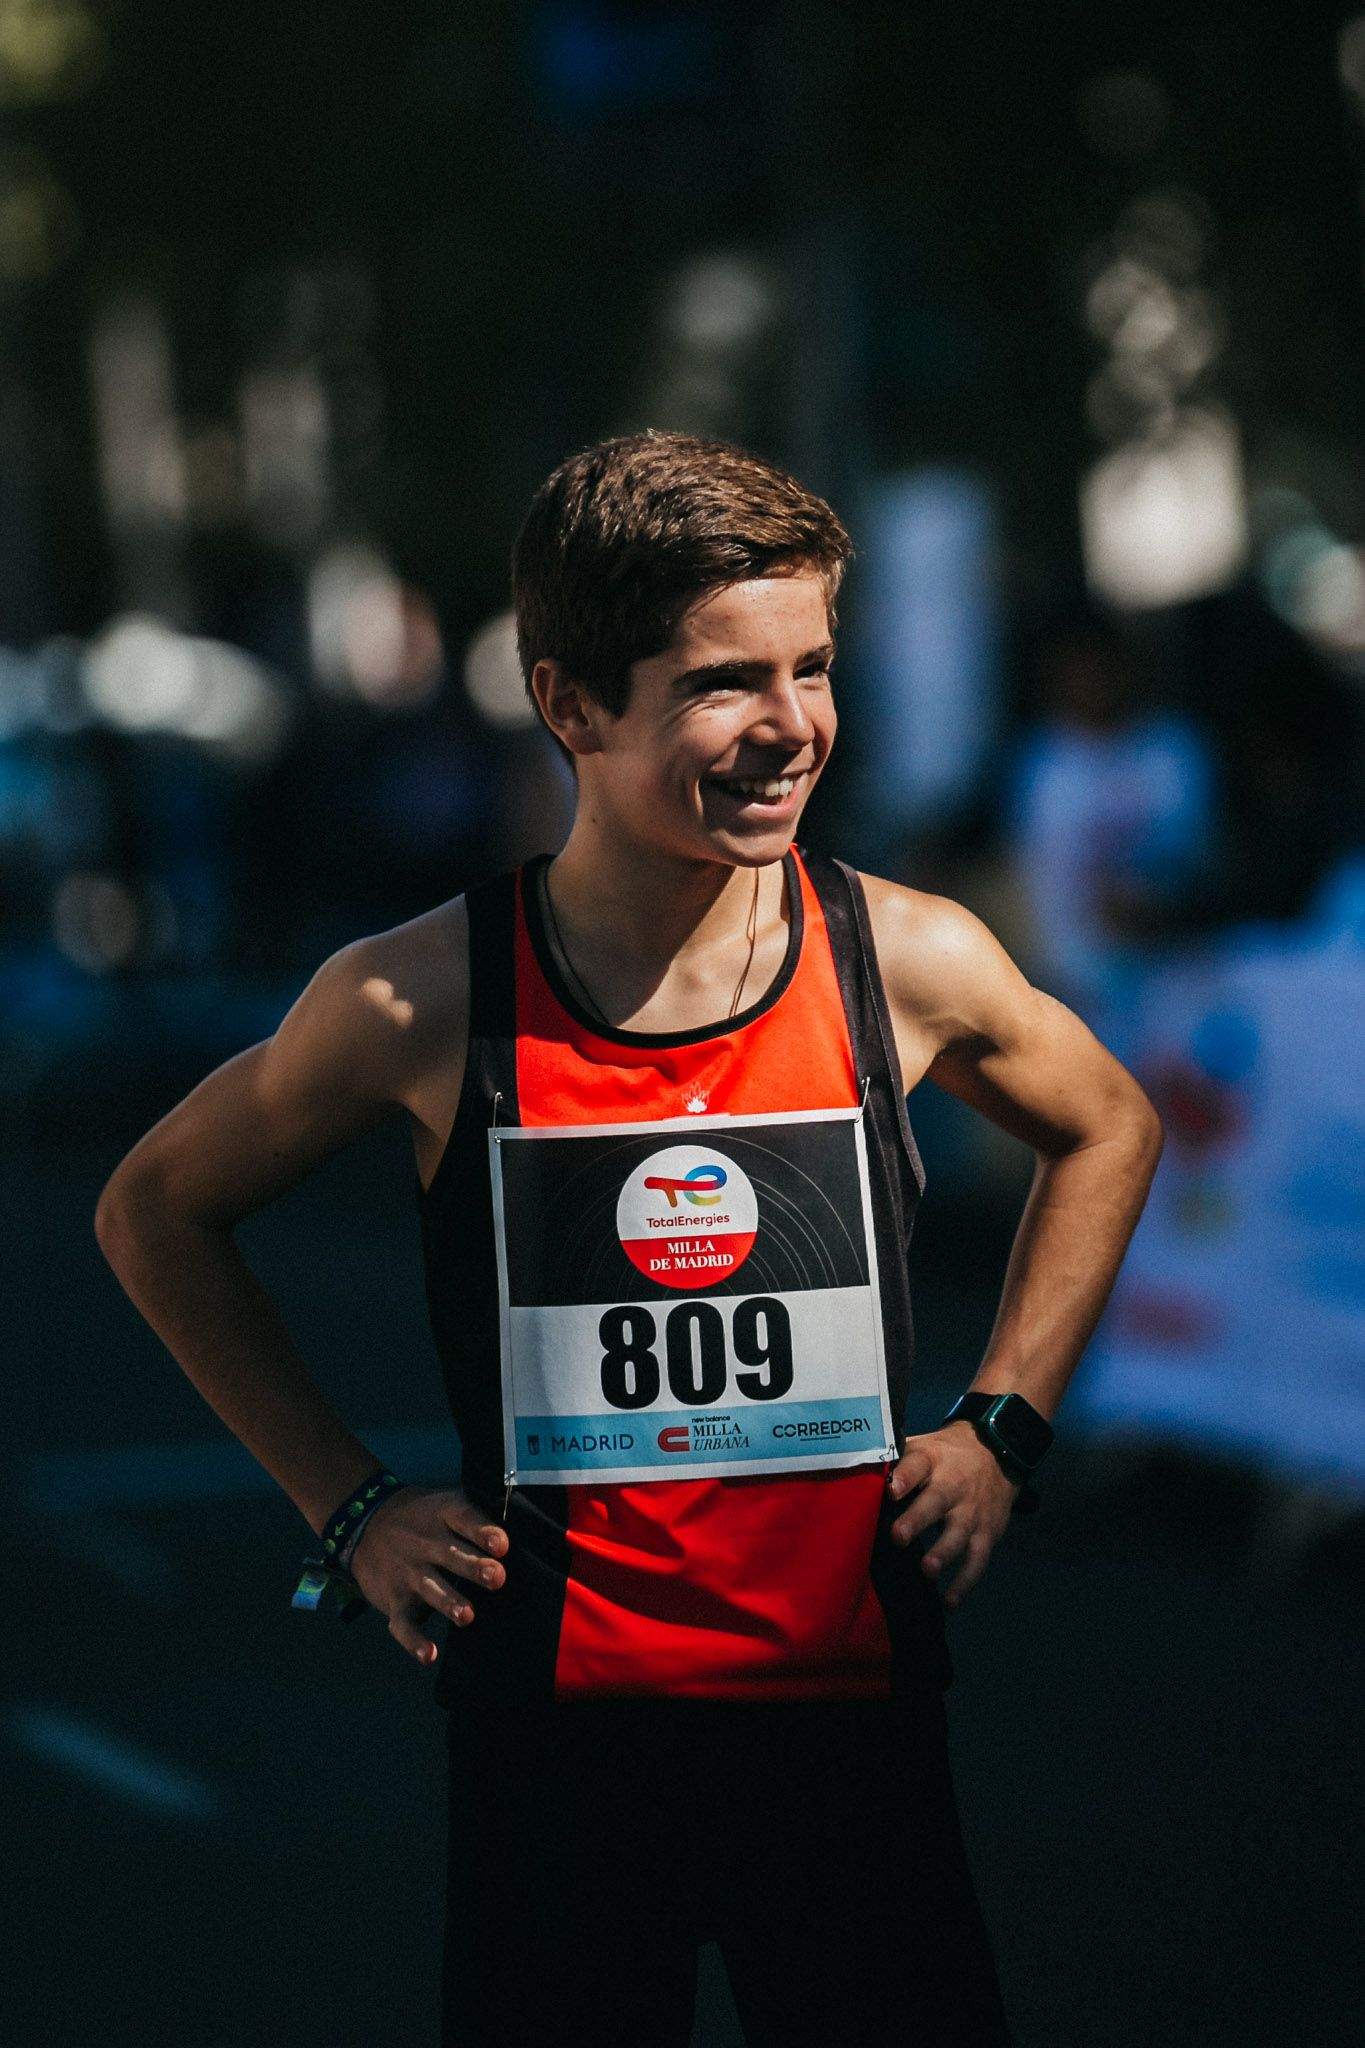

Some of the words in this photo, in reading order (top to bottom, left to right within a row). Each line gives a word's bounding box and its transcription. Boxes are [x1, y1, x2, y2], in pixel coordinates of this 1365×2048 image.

[646, 1213, 730, 1228] TotalEnergies
[667, 1240, 715, 1254] MILLA
[650, 1258, 670, 1271] DE
[674, 1254, 733, 1269] MADRID
[598, 1296, 794, 1410] 809
[693, 1422, 742, 1437] MILLA
[551, 1434, 634, 1452] MADRID
[693, 1434, 750, 1451] URBANA
